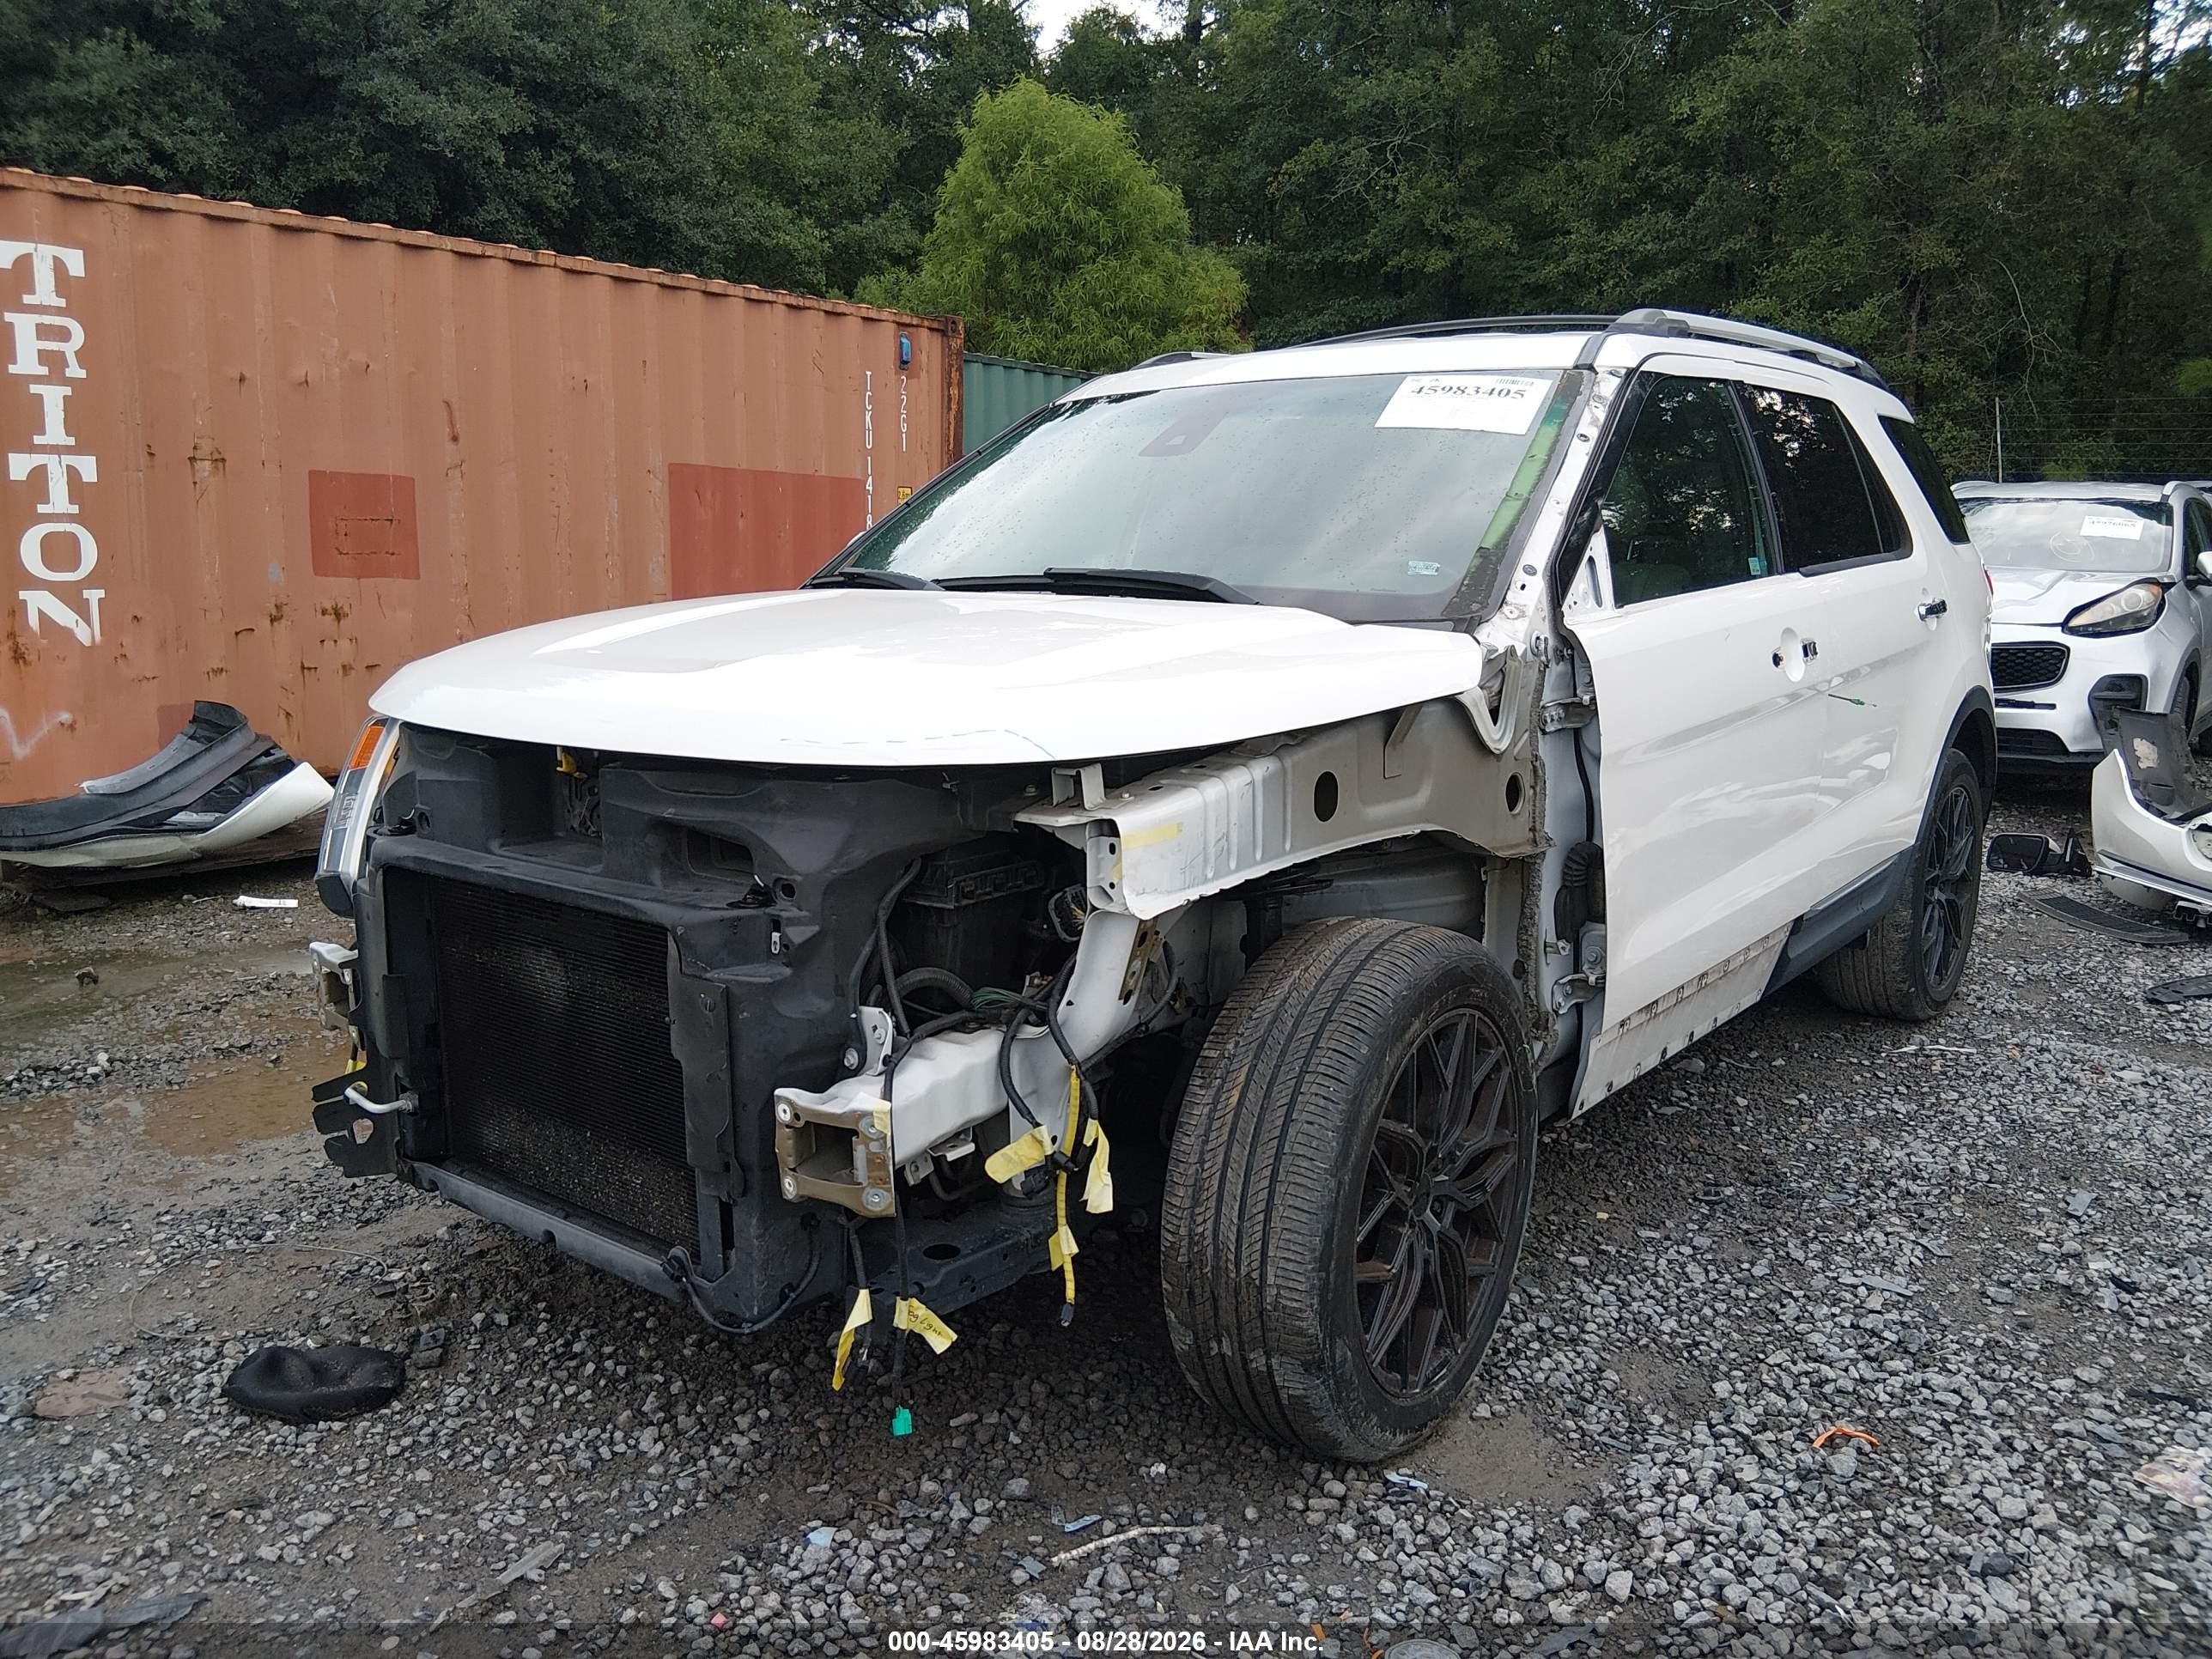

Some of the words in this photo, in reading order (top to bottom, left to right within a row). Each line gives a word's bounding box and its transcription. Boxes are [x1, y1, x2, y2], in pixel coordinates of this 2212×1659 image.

[865, 370, 873, 450] TCKU
[1412, 385, 1527, 399] 45983405
[0, 240, 106, 647] TRITON
